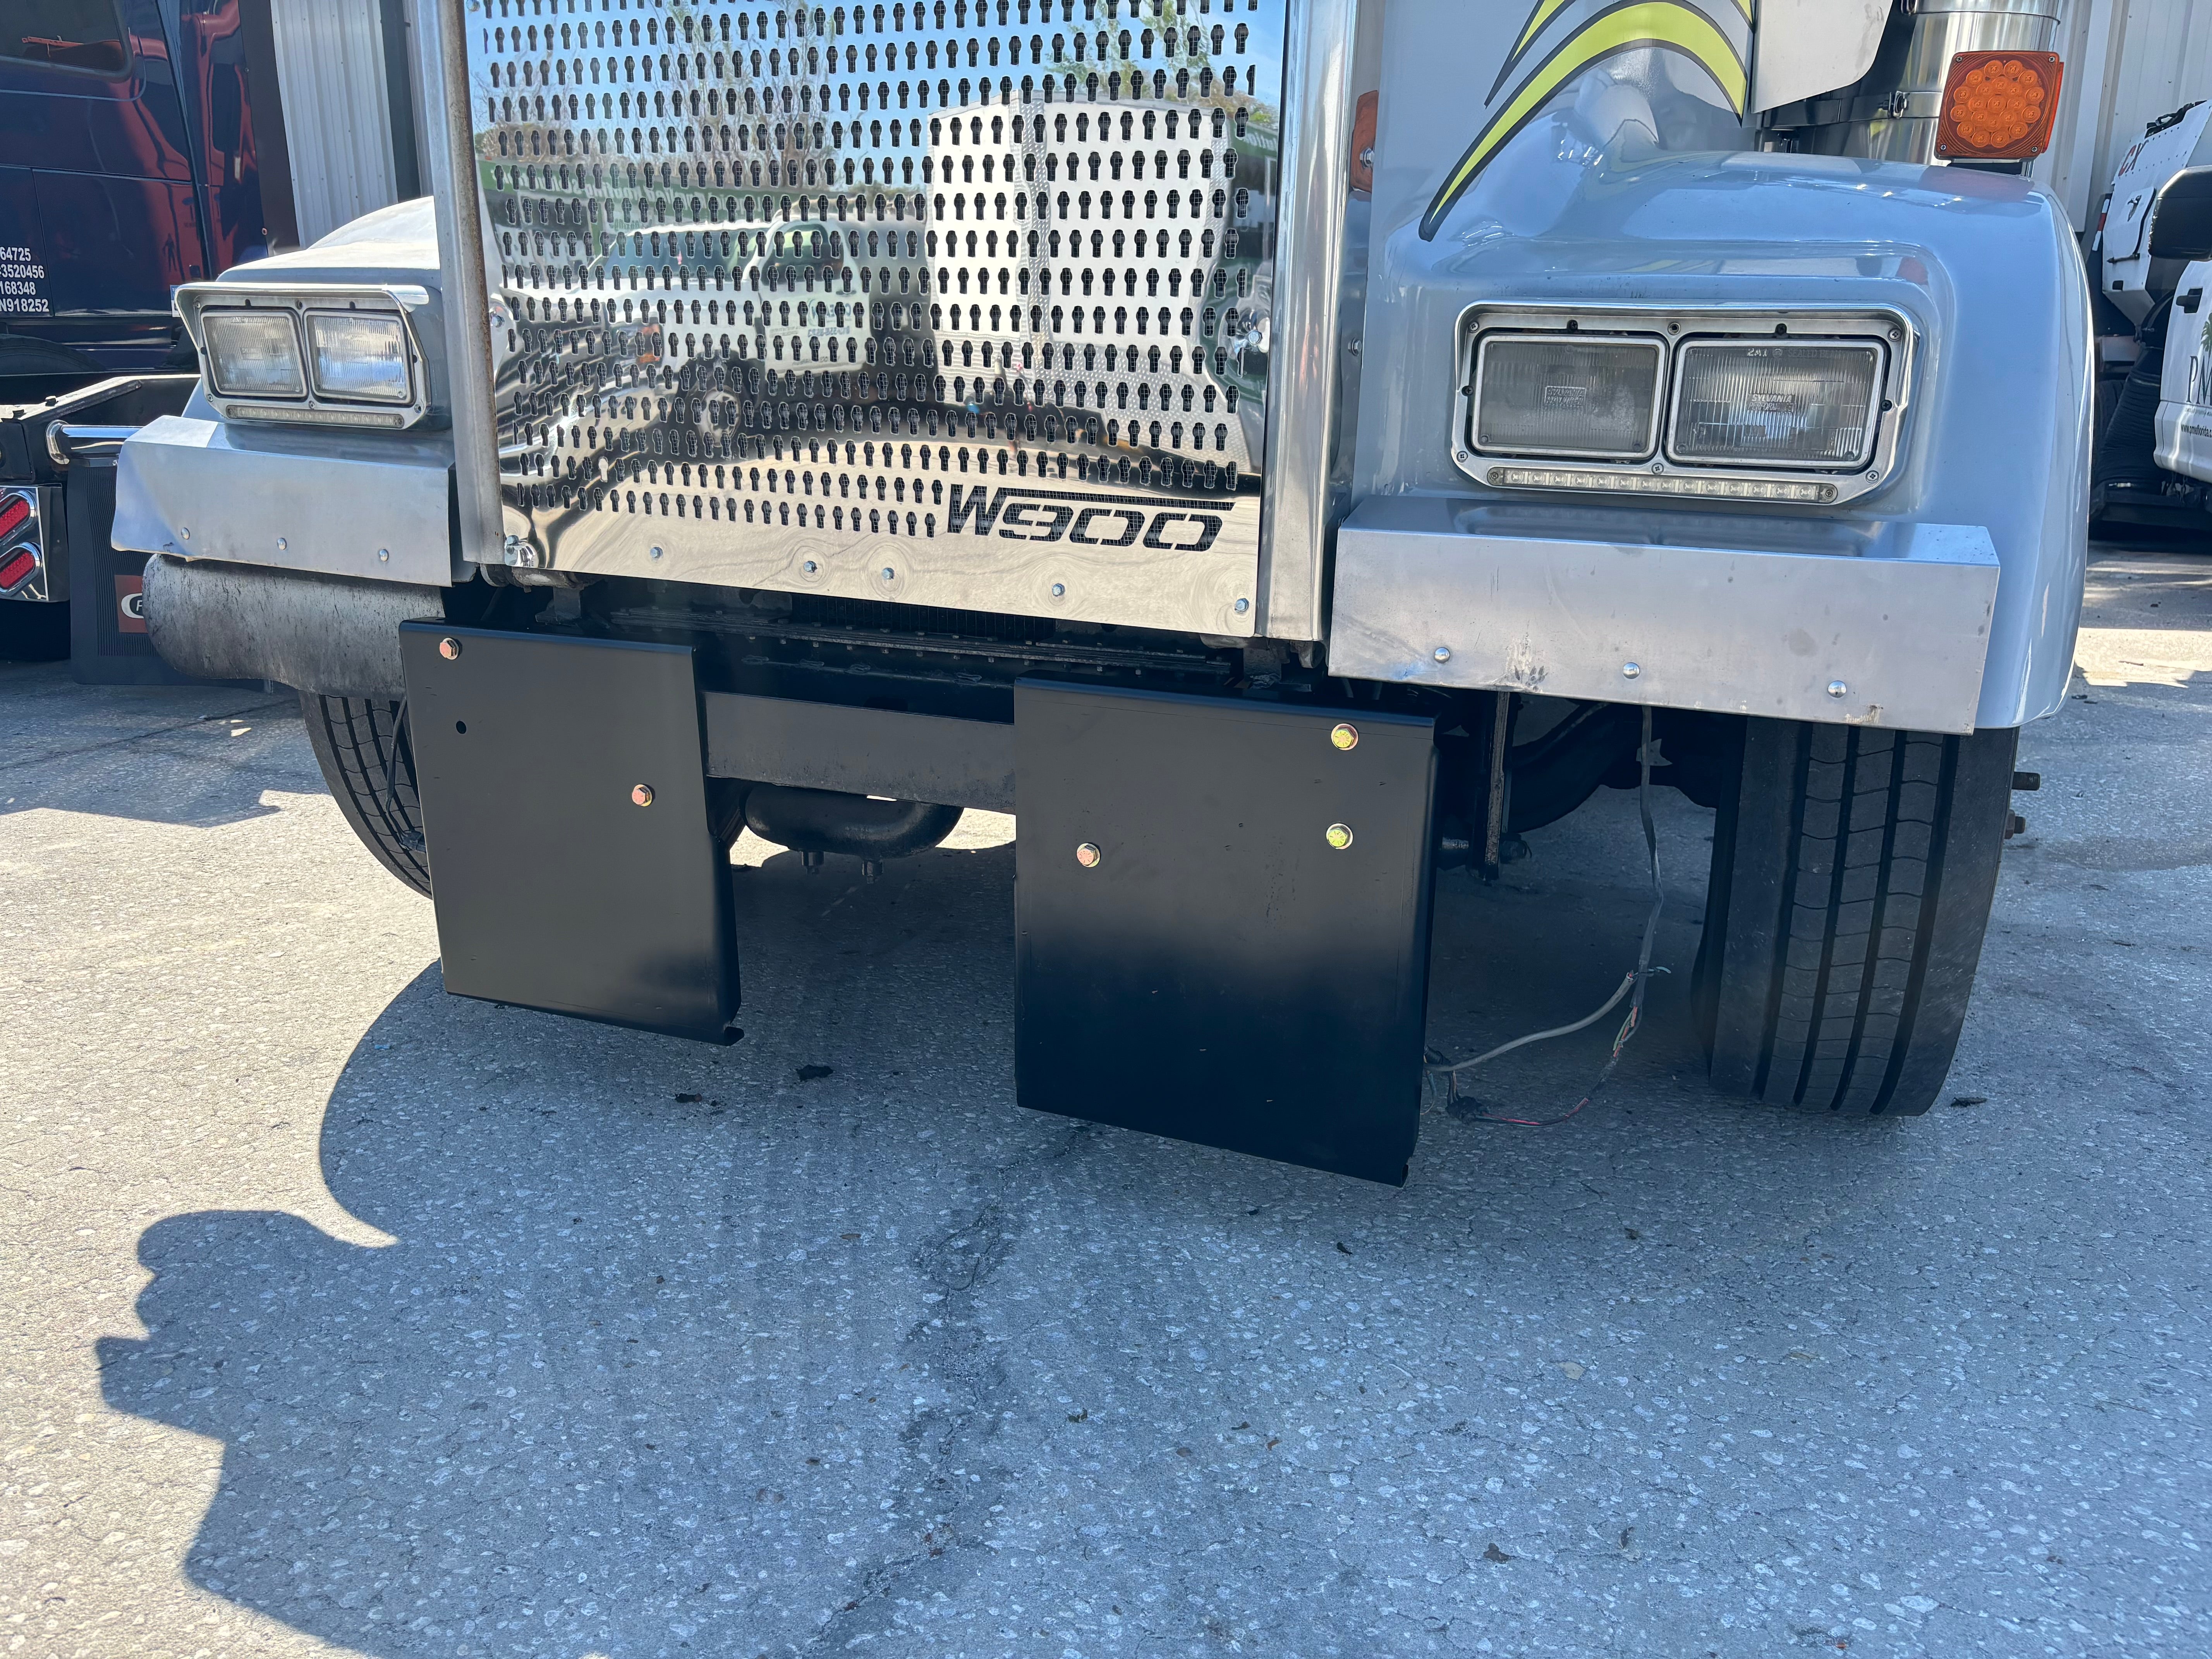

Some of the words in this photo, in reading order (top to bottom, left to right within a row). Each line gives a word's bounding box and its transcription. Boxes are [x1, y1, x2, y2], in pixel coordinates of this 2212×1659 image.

[0, 246, 31, 261] 64725
[0, 264, 45, 279] 3520456
[0, 298, 50, 312] N918252
[1752, 393, 1792, 403] SYLVANIA
[1748, 402, 1794, 413] PERFORMACE
[947, 484, 1236, 552] W900
